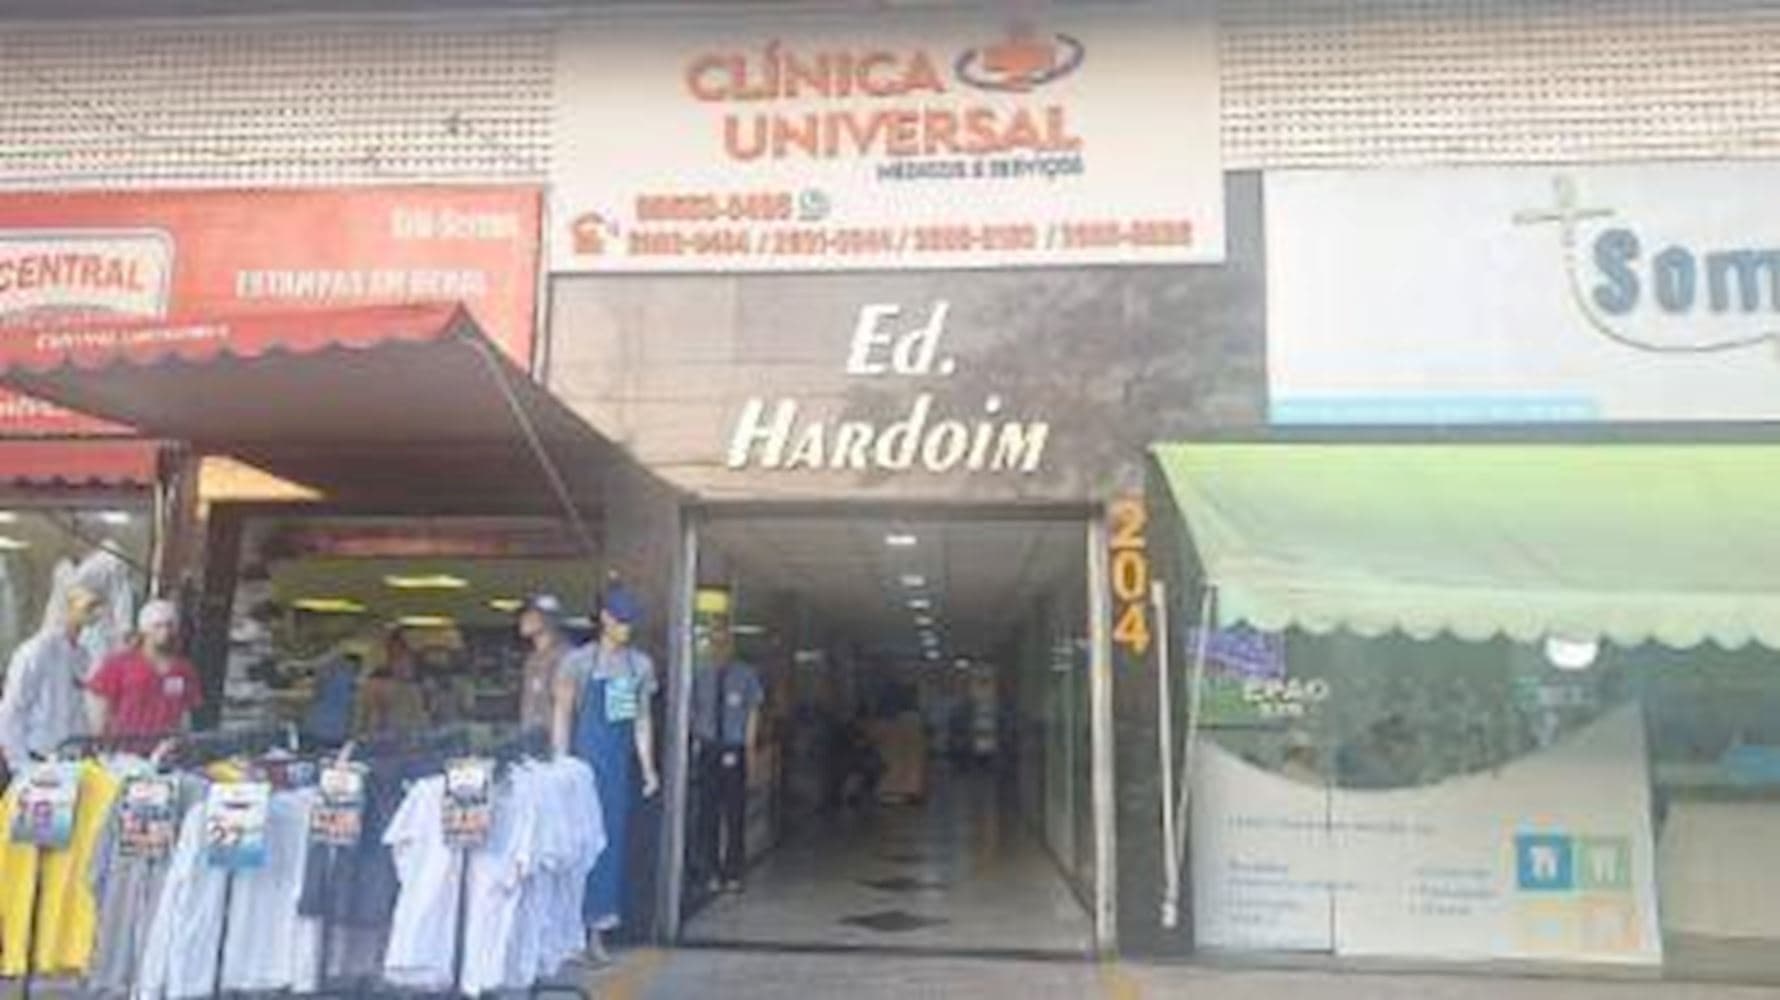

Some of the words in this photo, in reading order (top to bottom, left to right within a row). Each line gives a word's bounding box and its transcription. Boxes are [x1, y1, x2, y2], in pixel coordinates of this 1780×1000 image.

[686, 40, 946, 100] CLÍNICA
[724, 104, 1083, 161] UNIVERSAL
[0, 252, 145, 293] CENTRAL
[846, 302, 956, 376] Ed.
[1107, 502, 1150, 656] 204
